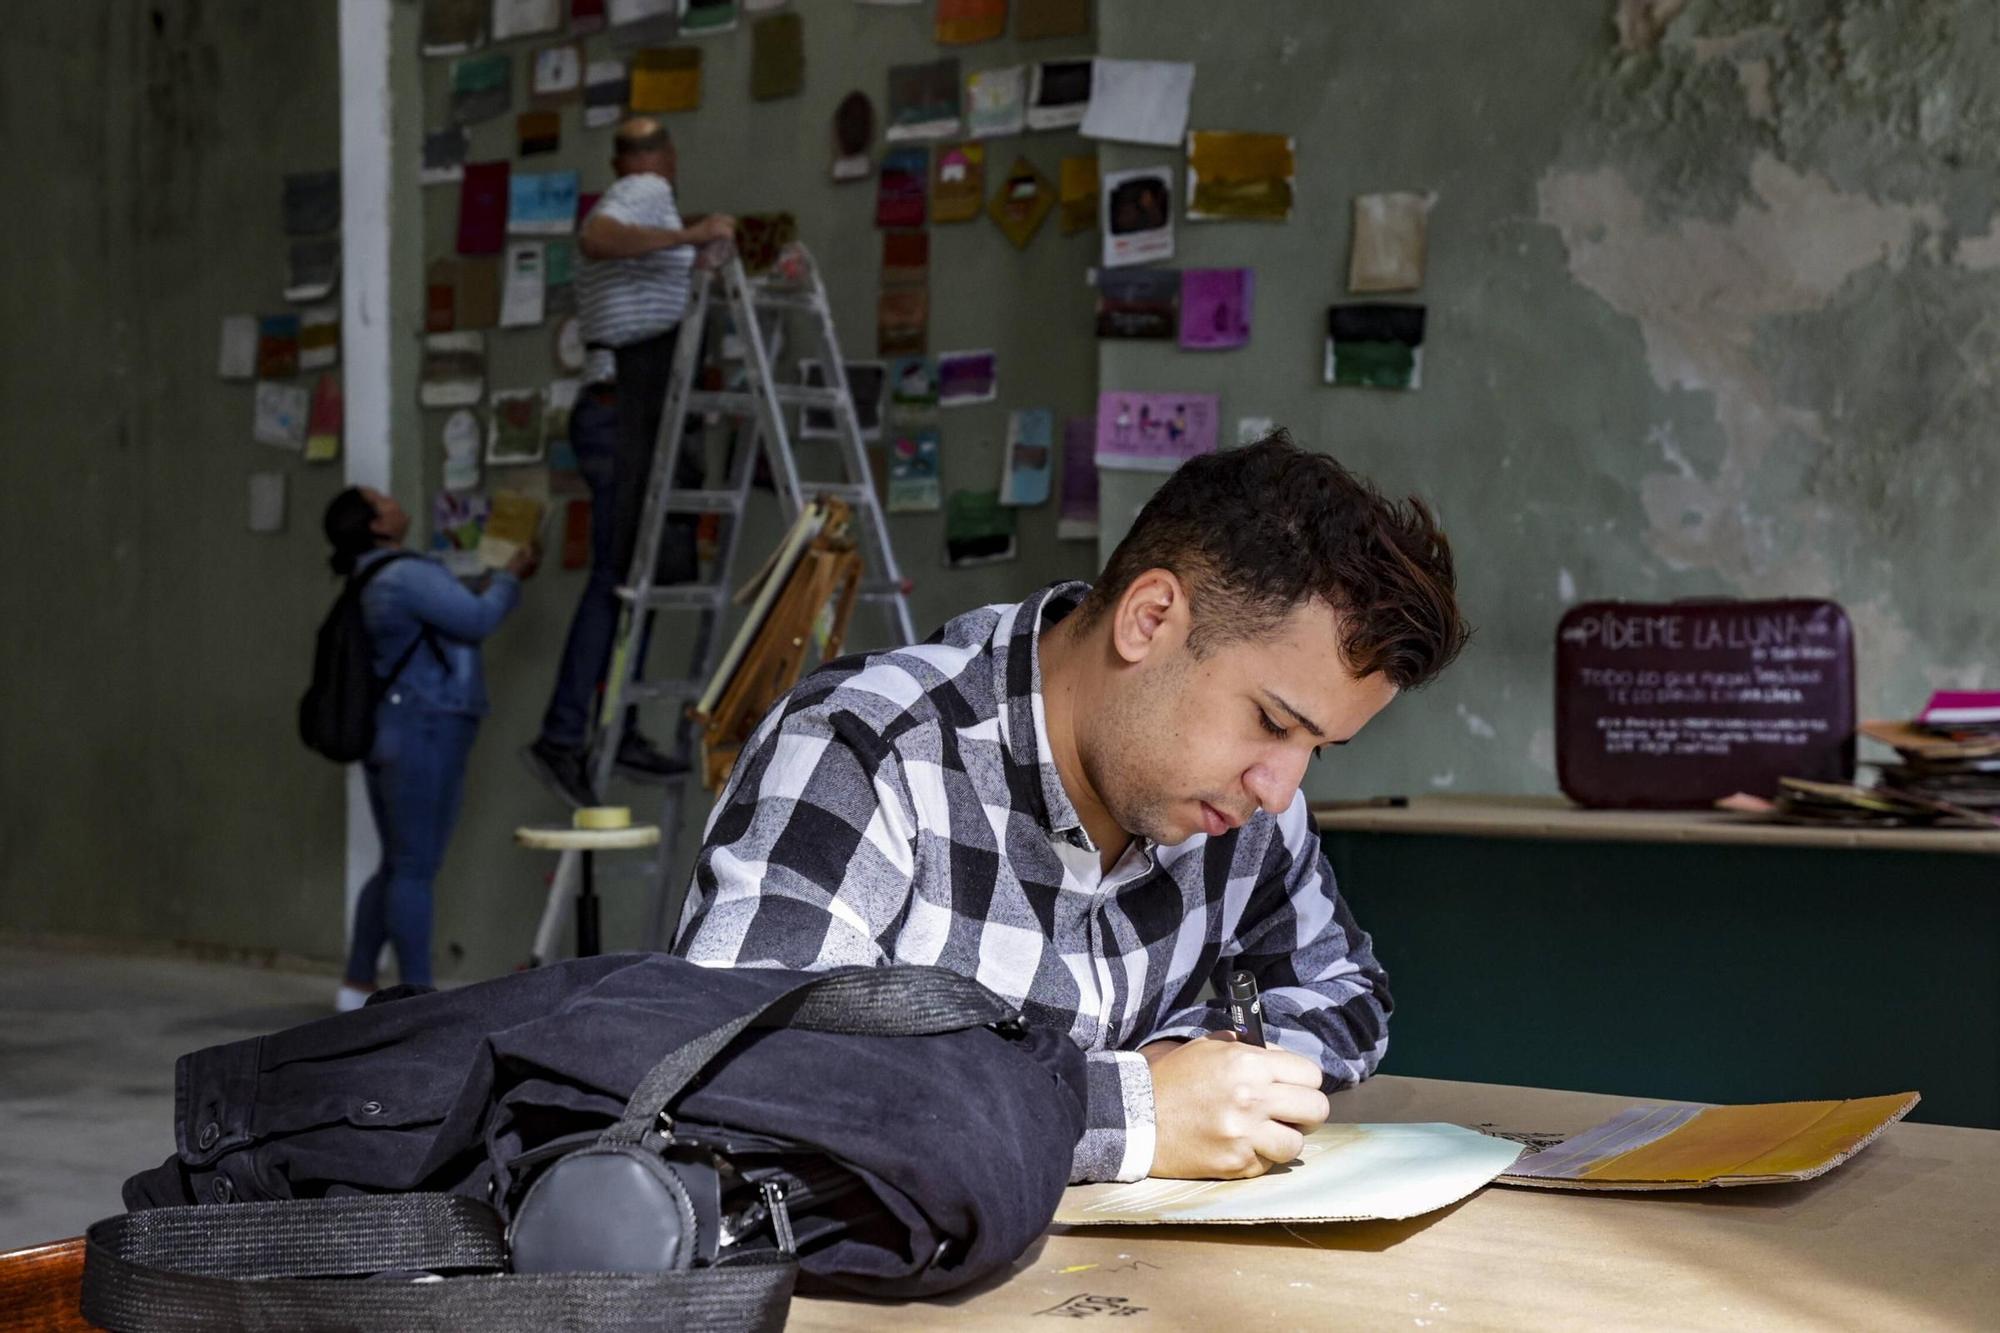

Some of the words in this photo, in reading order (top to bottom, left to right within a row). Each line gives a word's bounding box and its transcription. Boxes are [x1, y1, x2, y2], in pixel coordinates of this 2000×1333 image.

[1692, 619, 1723, 649] LA
[1726, 612, 1807, 649] LUNA
[1579, 667, 1634, 686] TODO
